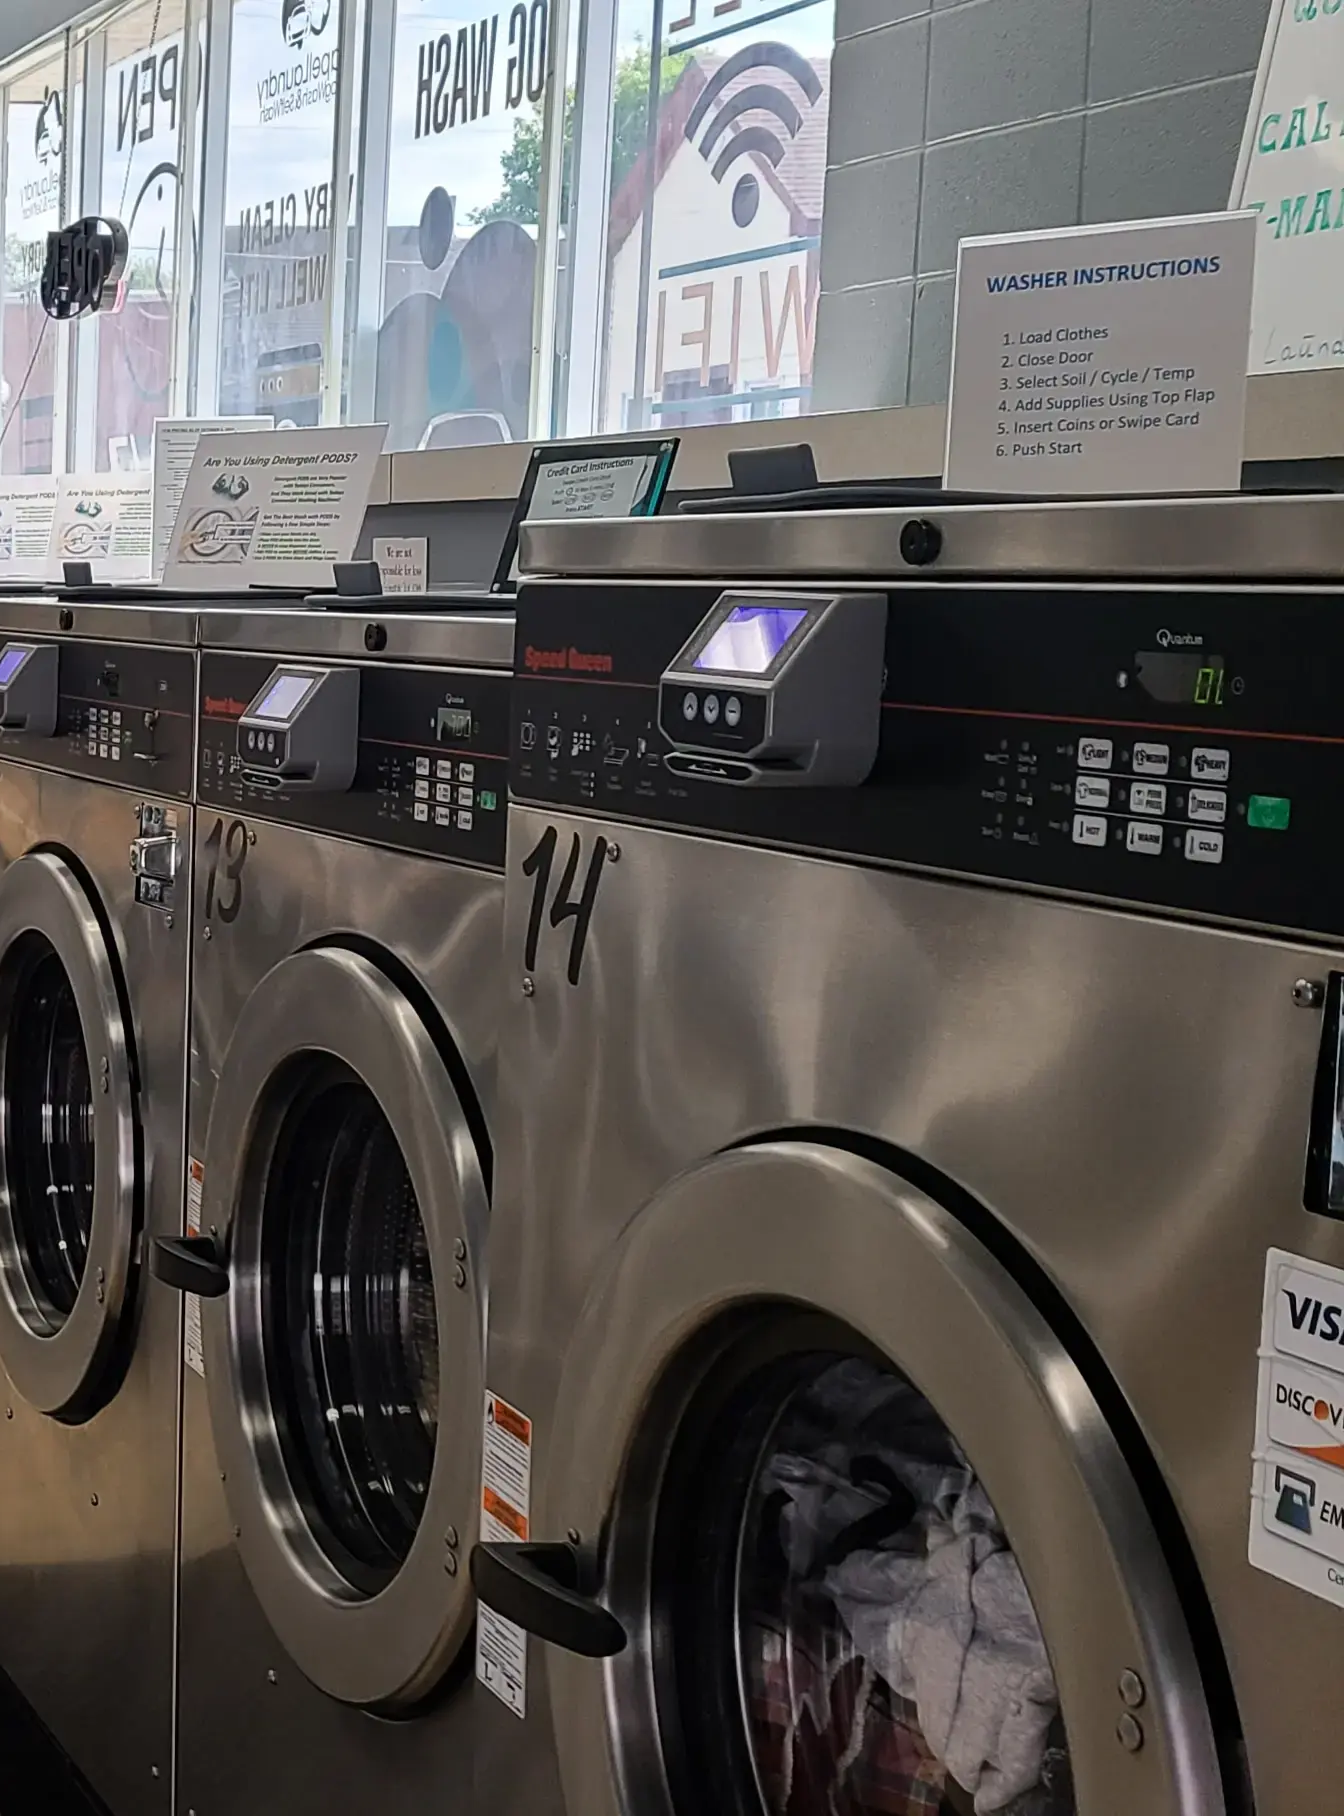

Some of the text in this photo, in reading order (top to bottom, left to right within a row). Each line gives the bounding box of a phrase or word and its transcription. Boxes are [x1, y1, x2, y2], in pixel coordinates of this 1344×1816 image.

[1258, 101, 1344, 154] CAL
[1247, 188, 1344, 239] -MA
[986, 256, 1220, 294] WASHER INSTRUCTIONS
[1003, 327, 1109, 346] 1. Load Clothes
[1001, 351, 1093, 369] 2. Close Door
[999, 366, 1195, 390] 3. Select Soil / Cycle / Temp
[998, 388, 1215, 412] 4. Add Supplies Using Top Flap
[997, 411, 1200, 435] 5. Insert Coins or Swipe Card
[203, 453, 358, 468] Are You Using Detergent PODS?
[996, 440, 1083, 457] 6. Push Start
[547, 458, 634, 478] Credit Card Instructions
[11, 493, 38, 501] Detergent
[80, 489, 93, 497] You
[95, 489, 115, 497] Using
[116, 488, 150, 497] Detergent
[1156, 629, 1203, 646] Quantum
[524, 645, 613, 672] Speed Queen
[204, 816, 249, 924] 13
[522, 825, 608, 986] 14
[1282, 1288, 1344, 1345] VIS
[1275, 1383, 1344, 1430] DISCOV
